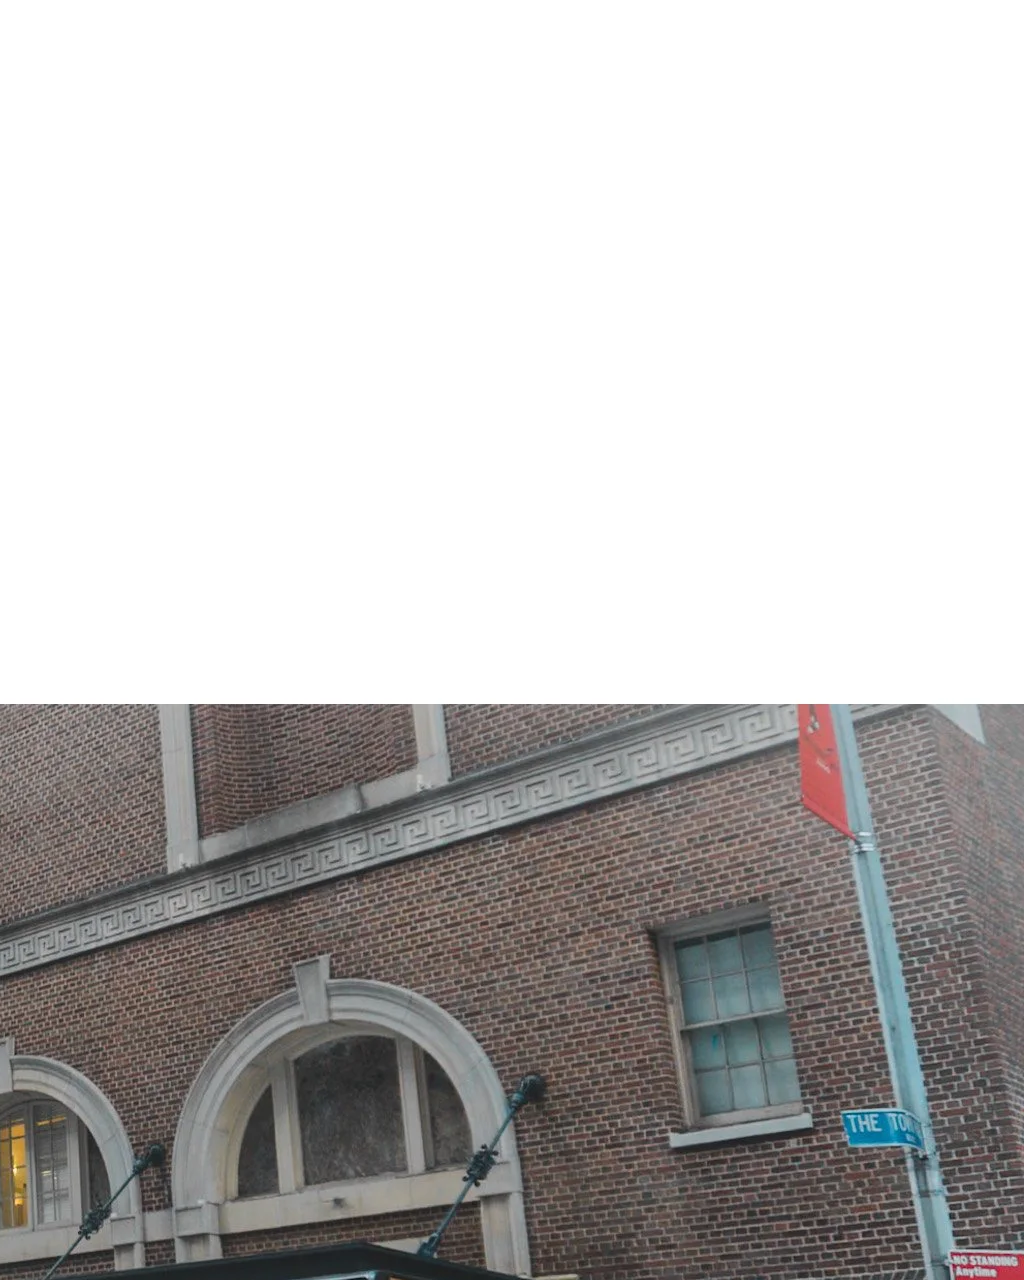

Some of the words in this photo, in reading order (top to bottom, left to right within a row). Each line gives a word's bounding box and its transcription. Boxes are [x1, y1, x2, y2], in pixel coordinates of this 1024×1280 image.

[846, 1113, 882, 1133] THE
[952, 1255, 968, 1266] NO
[969, 1256, 1019, 1267] STANDING
[956, 1266, 998, 1278] Anytime
